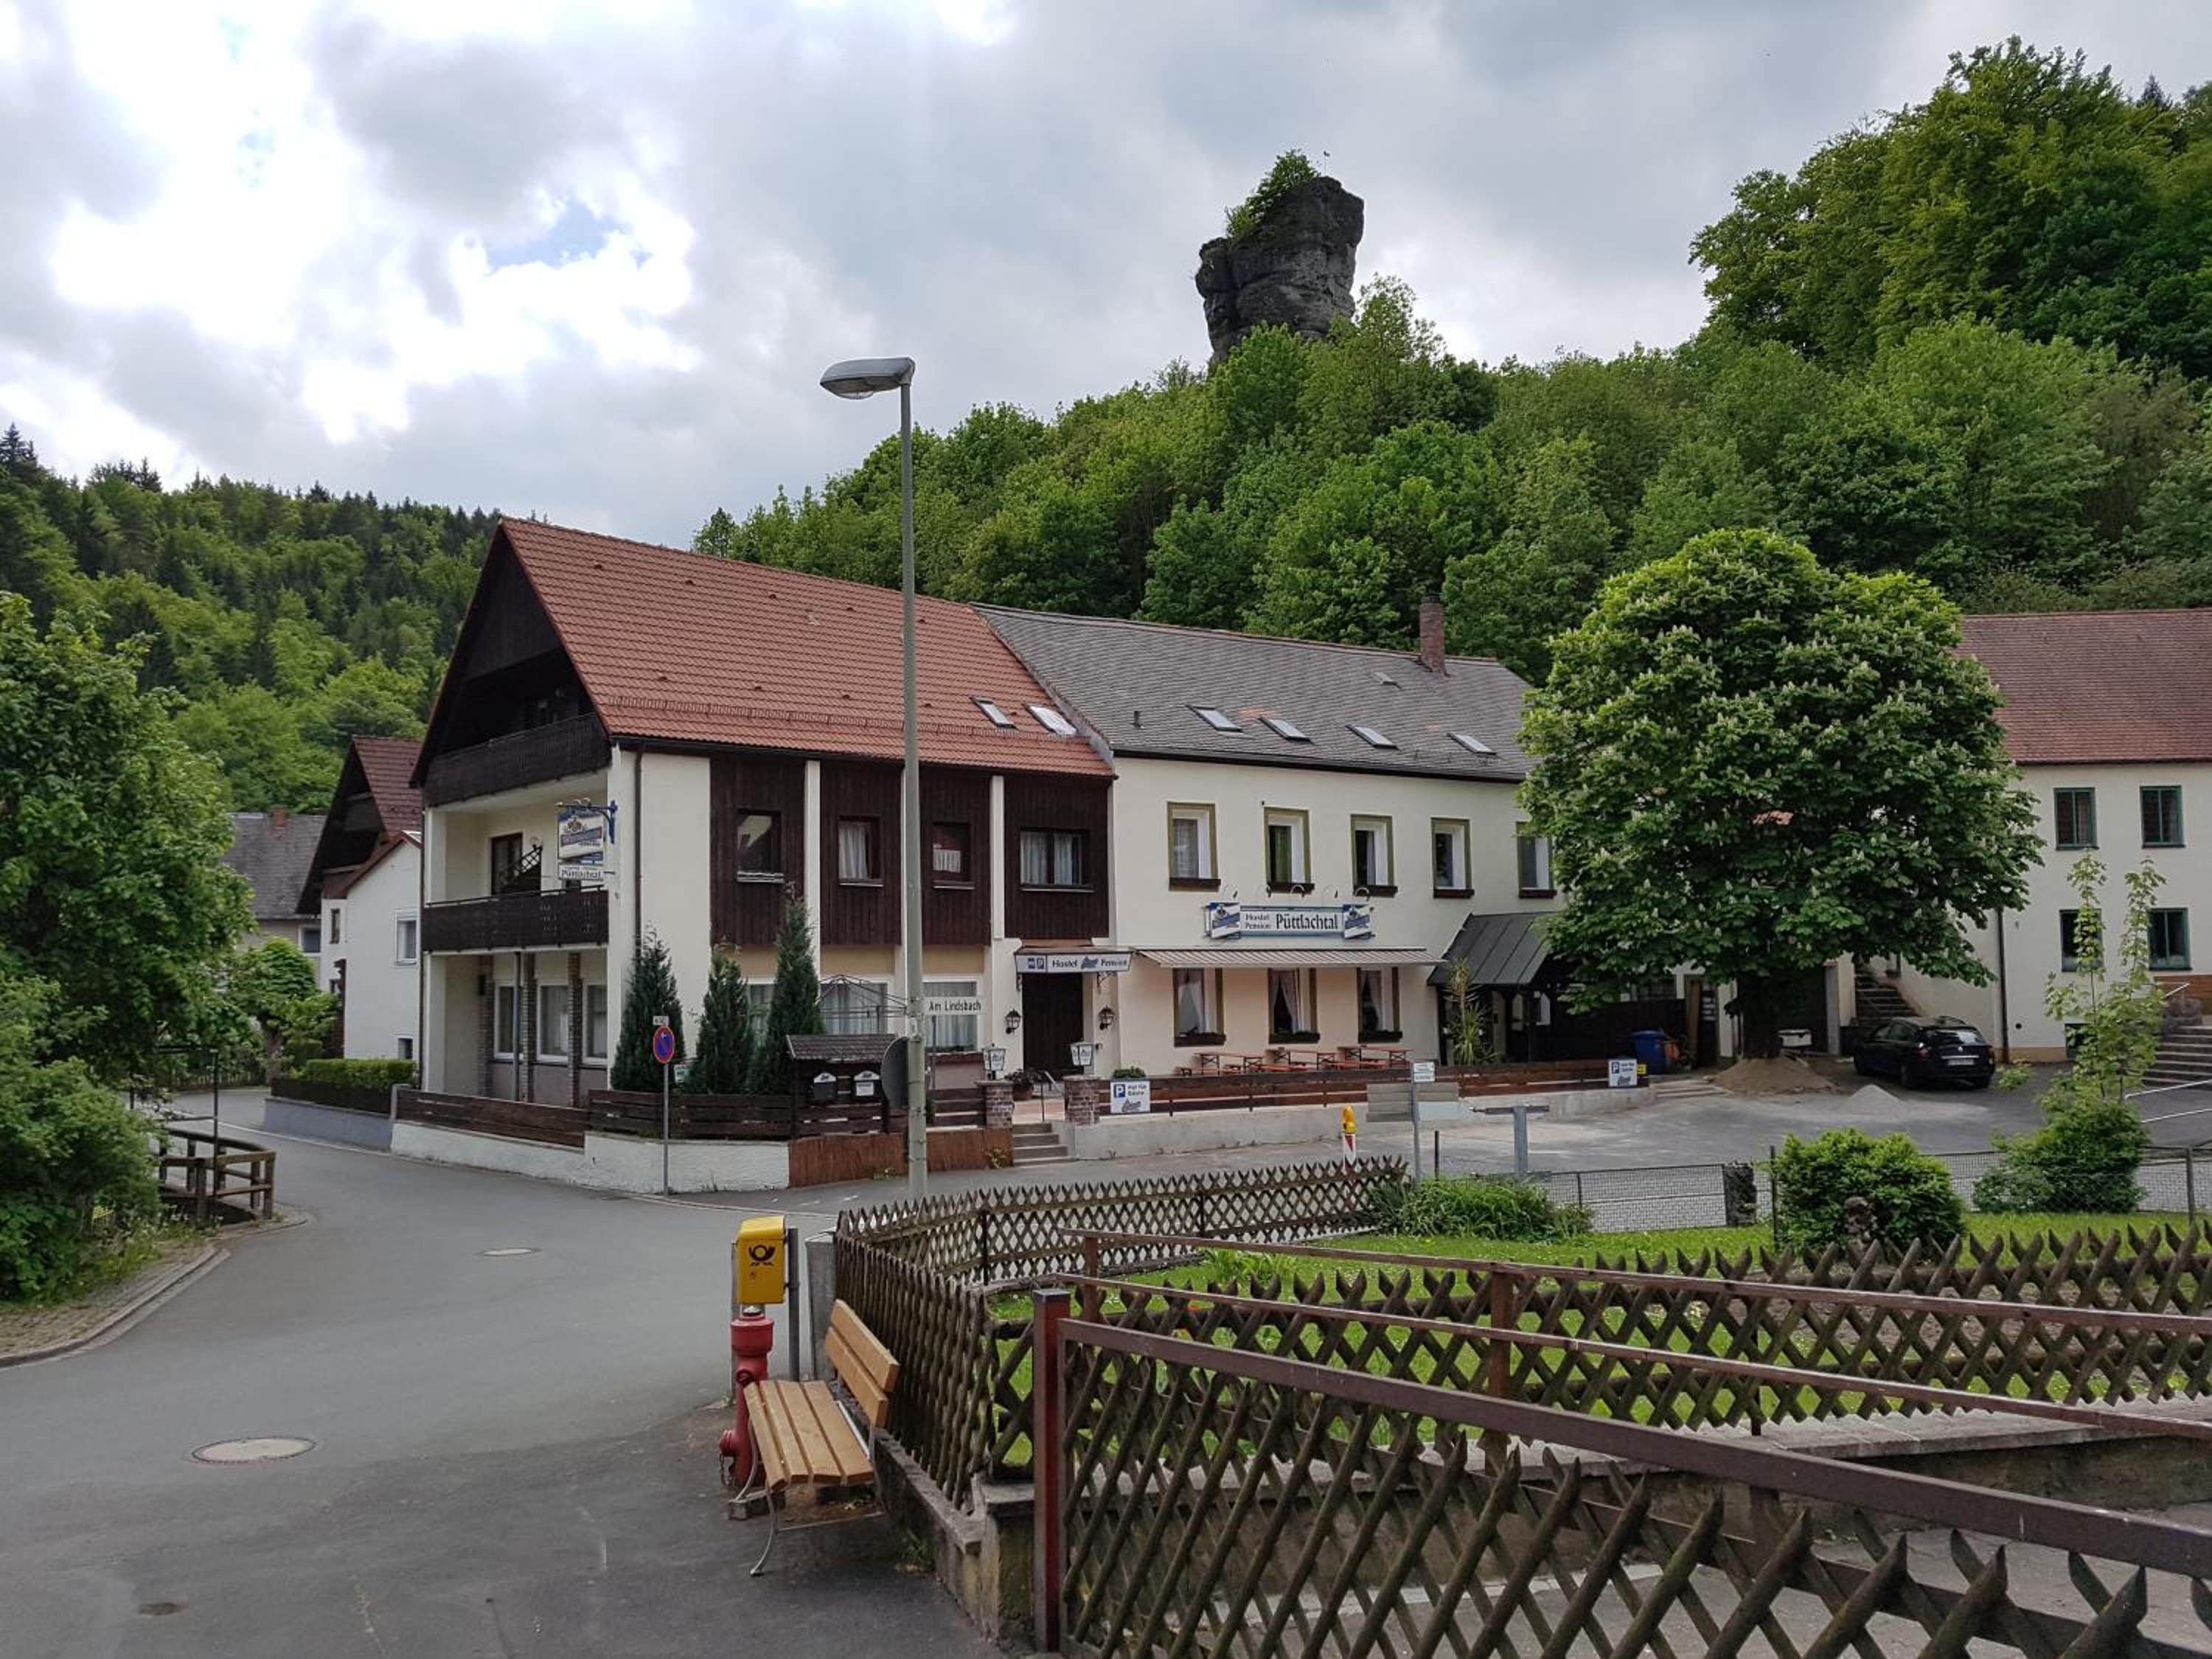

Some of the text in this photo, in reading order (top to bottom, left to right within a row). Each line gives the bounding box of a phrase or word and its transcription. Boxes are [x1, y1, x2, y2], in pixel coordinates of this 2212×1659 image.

[1276, 914, 1338, 930] Püttlachtal
[929, 1000, 981, 1011] Am Lindsbach
[1116, 1085, 1124, 1096] P
